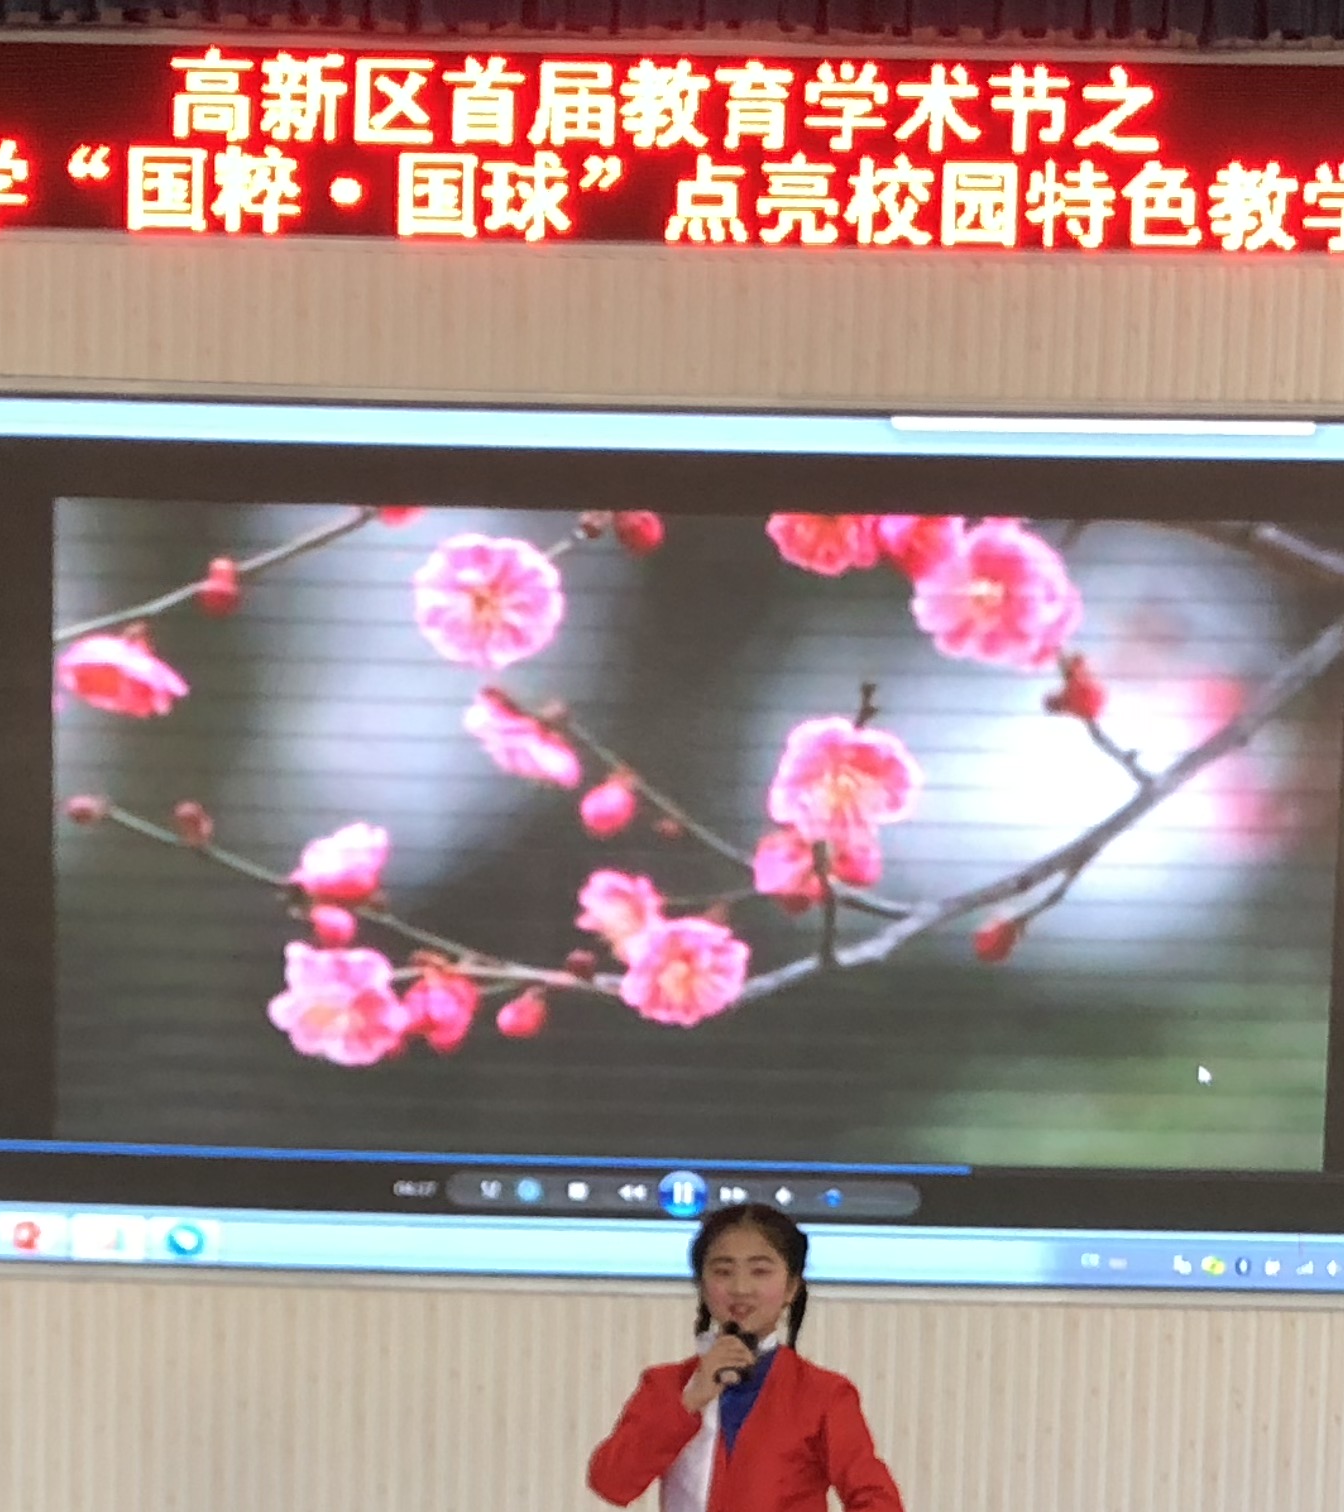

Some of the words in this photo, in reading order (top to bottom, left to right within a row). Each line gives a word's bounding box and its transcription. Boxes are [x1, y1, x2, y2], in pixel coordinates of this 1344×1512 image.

[172, 52, 1158, 154] 高新区首届教育学术节之
